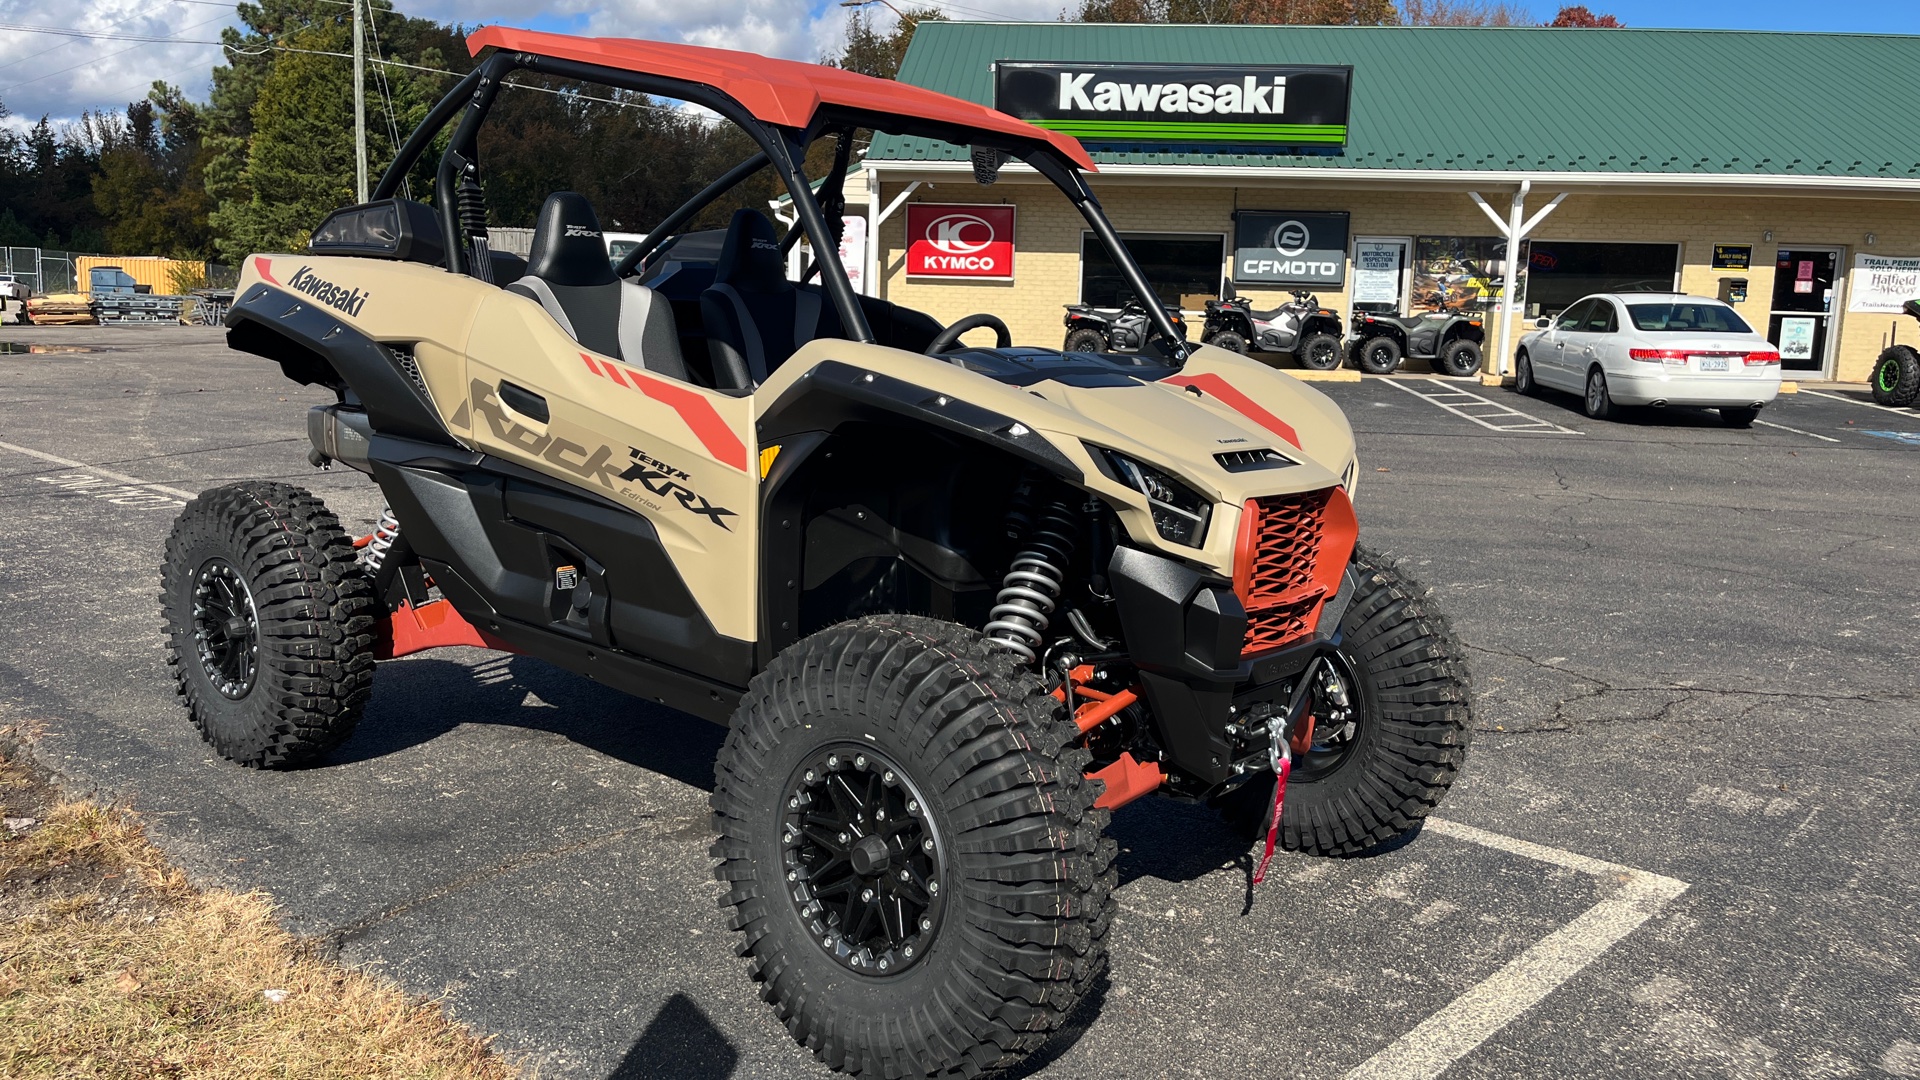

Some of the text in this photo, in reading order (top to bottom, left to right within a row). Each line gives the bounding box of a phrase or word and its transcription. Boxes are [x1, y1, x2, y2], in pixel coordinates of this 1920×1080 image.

[1058, 72, 1286, 115] Kawasaki
[564, 229, 600, 238] KRX
[750, 242, 778, 251] KRX
[924, 256, 995, 271] KYMCO
[1243, 260, 1337, 276] CFMOTO
[1530, 252, 1558, 270] OPEN
[1864, 258, 1889, 266] TRAIL
[1871, 273, 1917, 288] Hatfield
[287, 265, 370, 318] Kawasaki
[450, 377, 628, 491] Rock
[627, 445, 691, 482] TERYX
[618, 459, 740, 534] KRX
